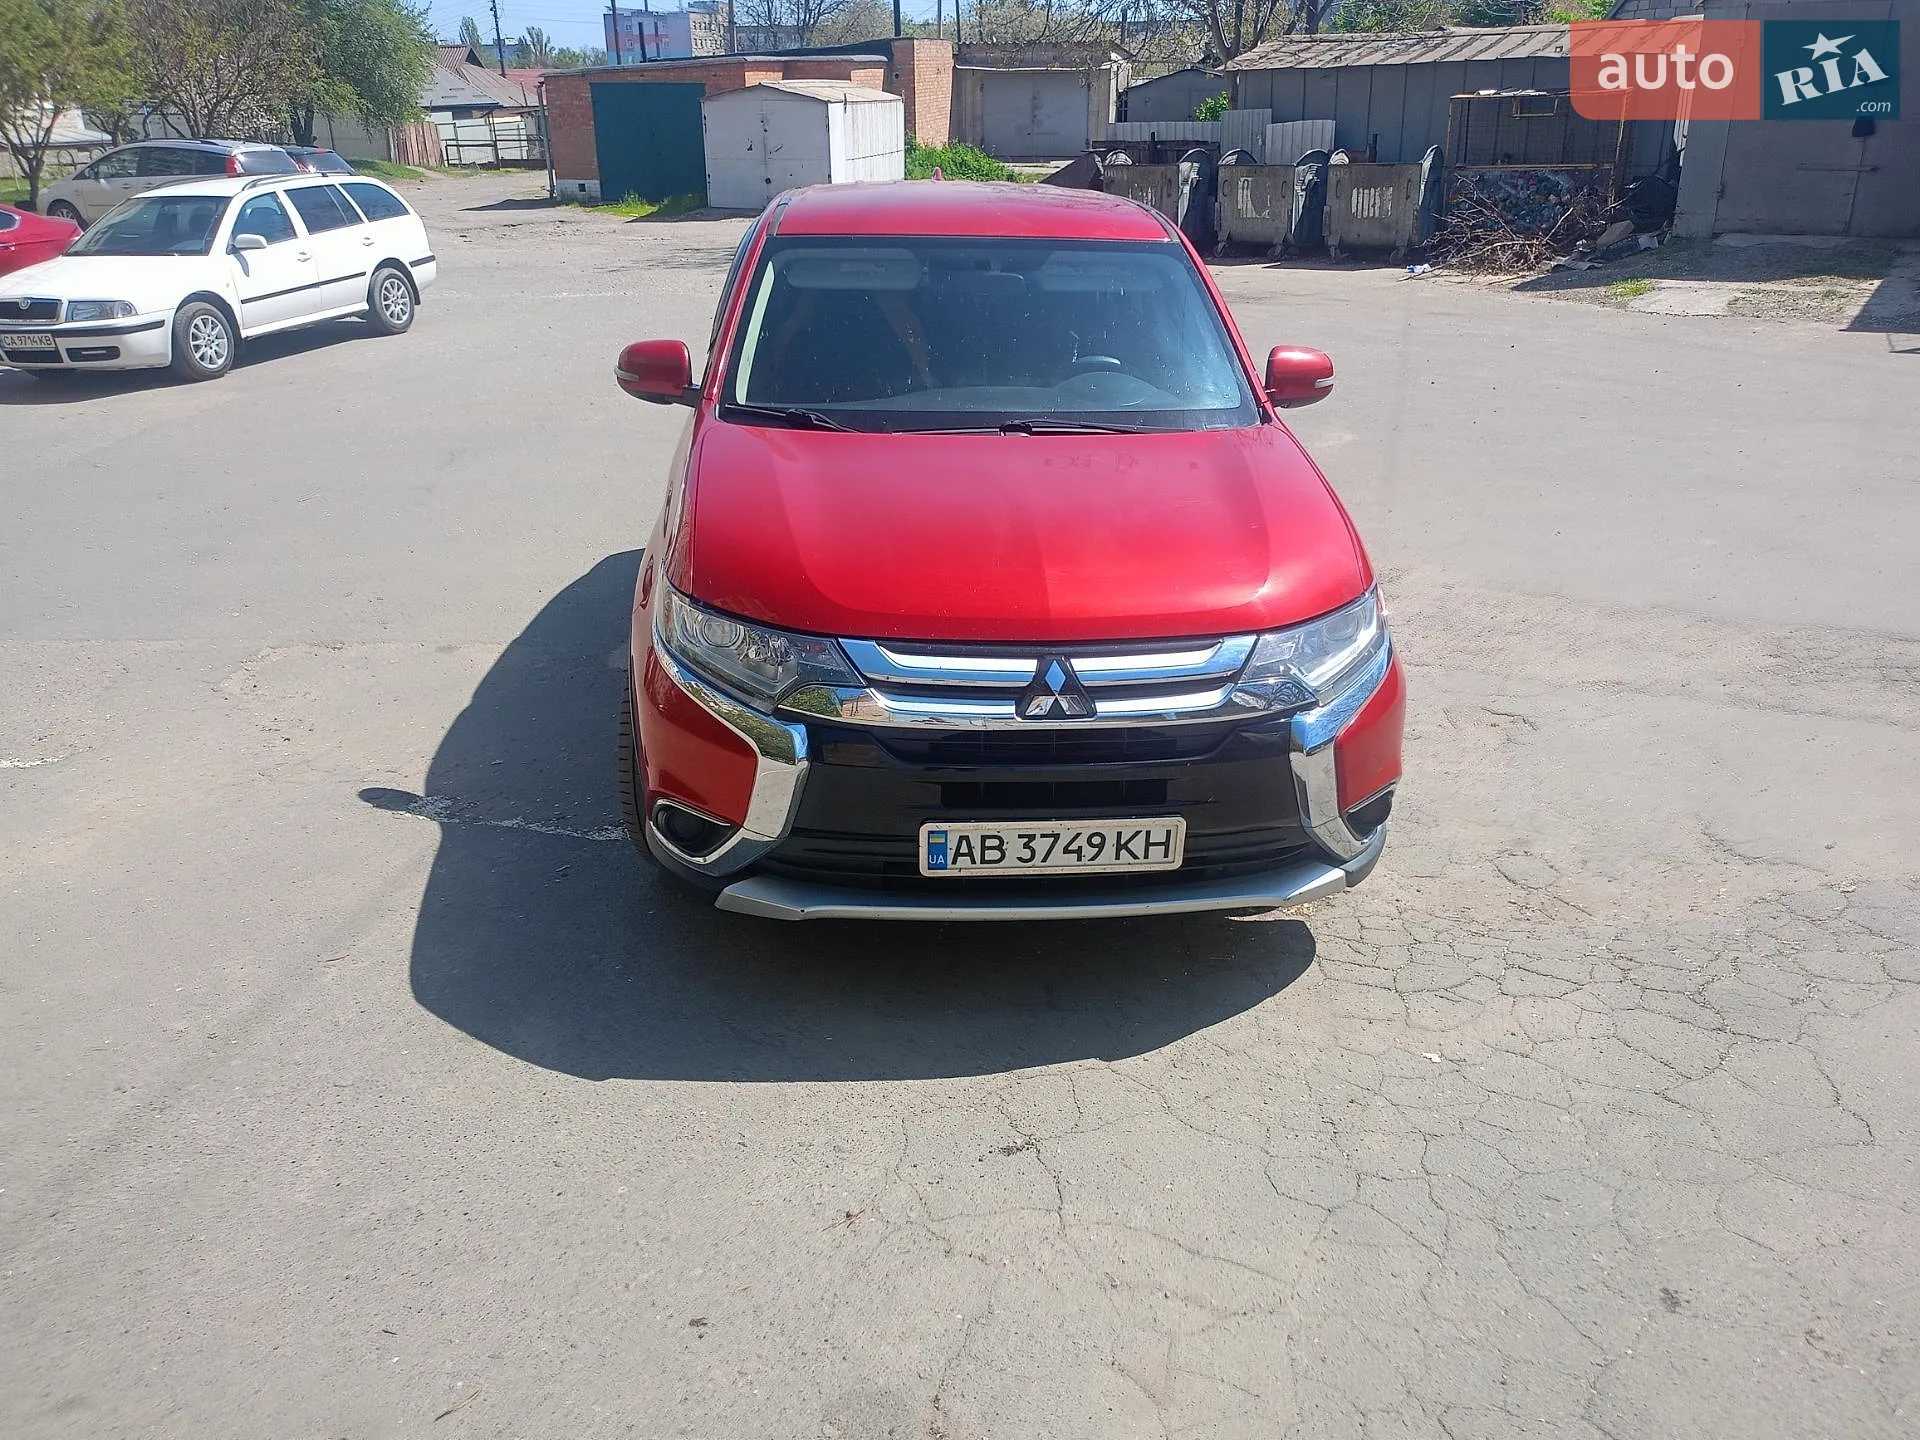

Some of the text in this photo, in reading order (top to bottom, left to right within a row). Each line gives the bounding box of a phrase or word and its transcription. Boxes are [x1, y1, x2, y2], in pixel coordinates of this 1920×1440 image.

[3, 335, 53, 346] CA 9714 KB
[951, 829, 1172, 865] AB 3749 KH
[929, 854, 945, 865] UA
